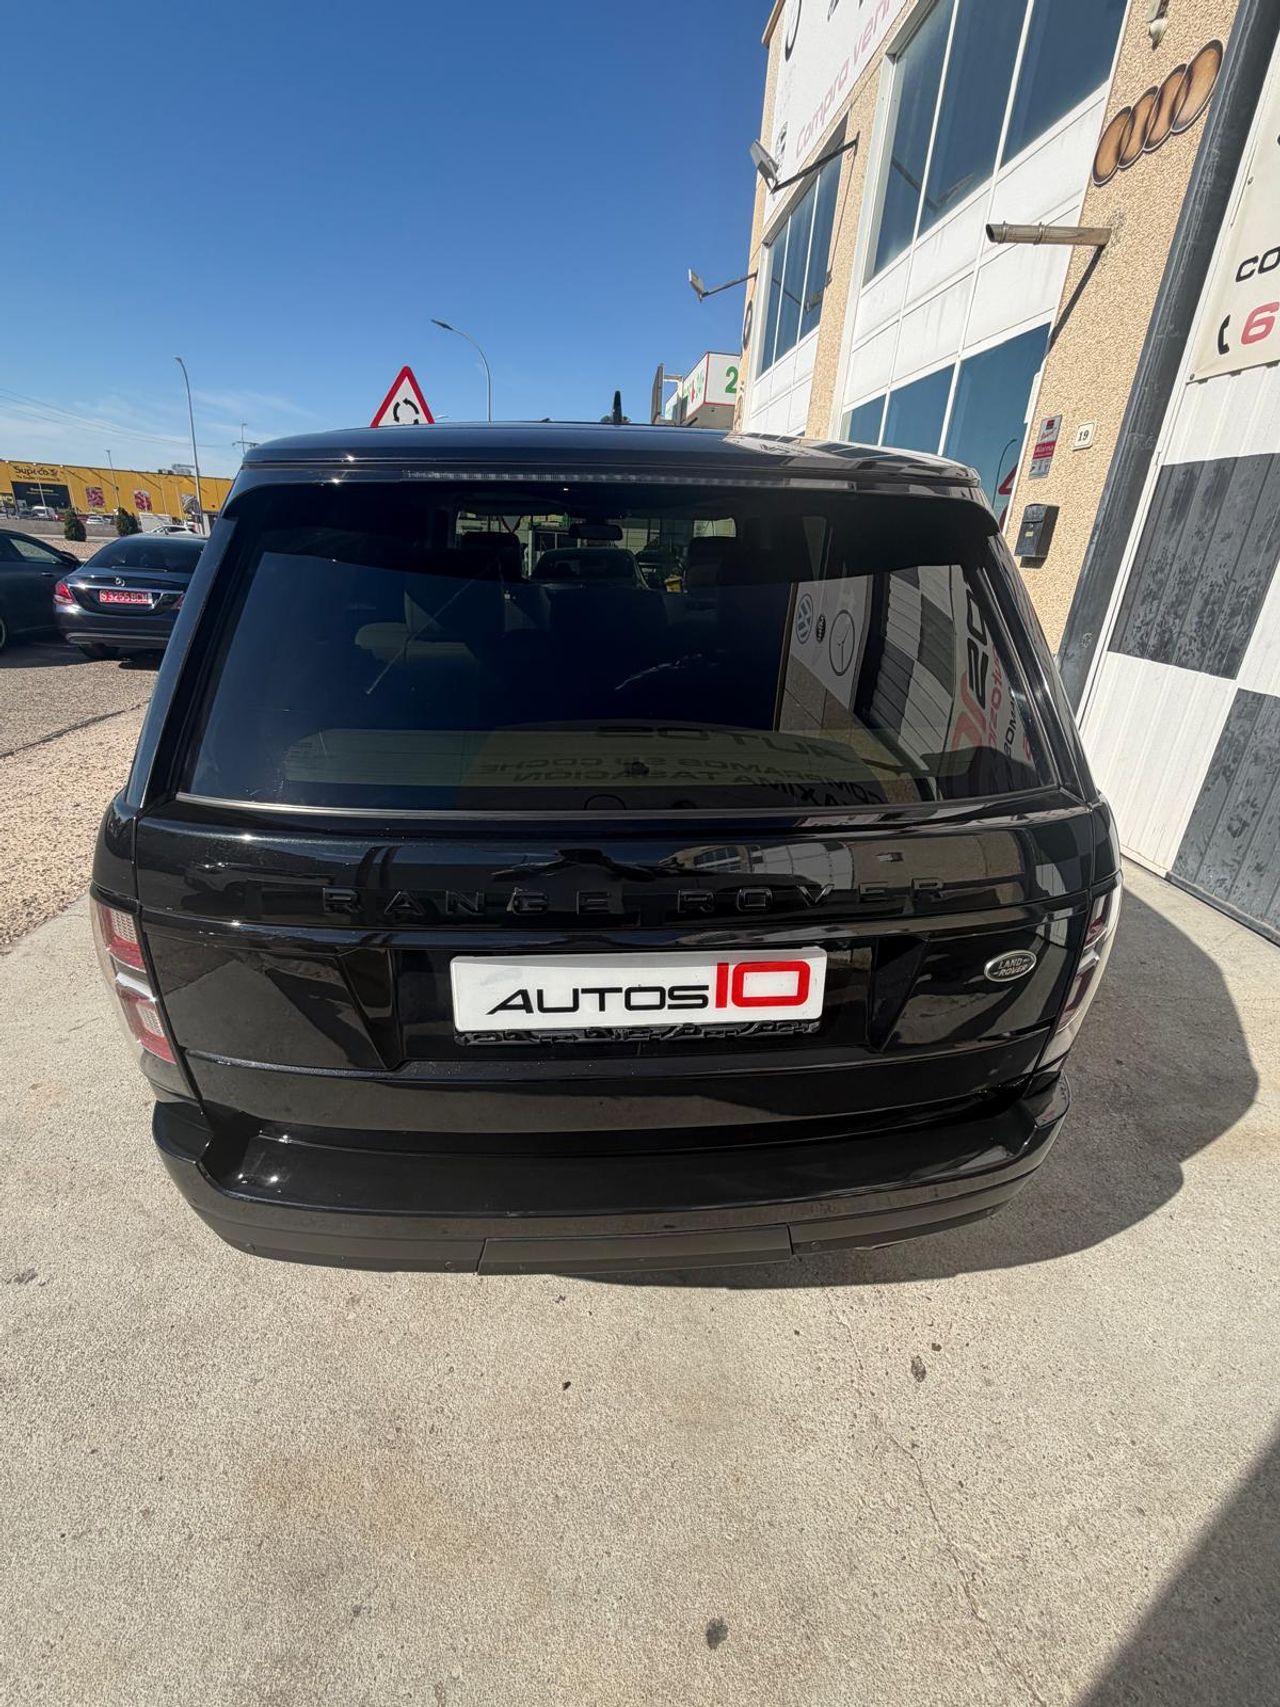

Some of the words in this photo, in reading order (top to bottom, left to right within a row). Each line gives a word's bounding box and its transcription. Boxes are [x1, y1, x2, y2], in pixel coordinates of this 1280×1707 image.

[1077, 429, 1089, 442] 19
[321, 887, 613, 916] RANGE
[676, 877, 944, 913] ROVER
[998, 958, 1022, 969] LAND
[998, 965, 1027, 976] ROVER
